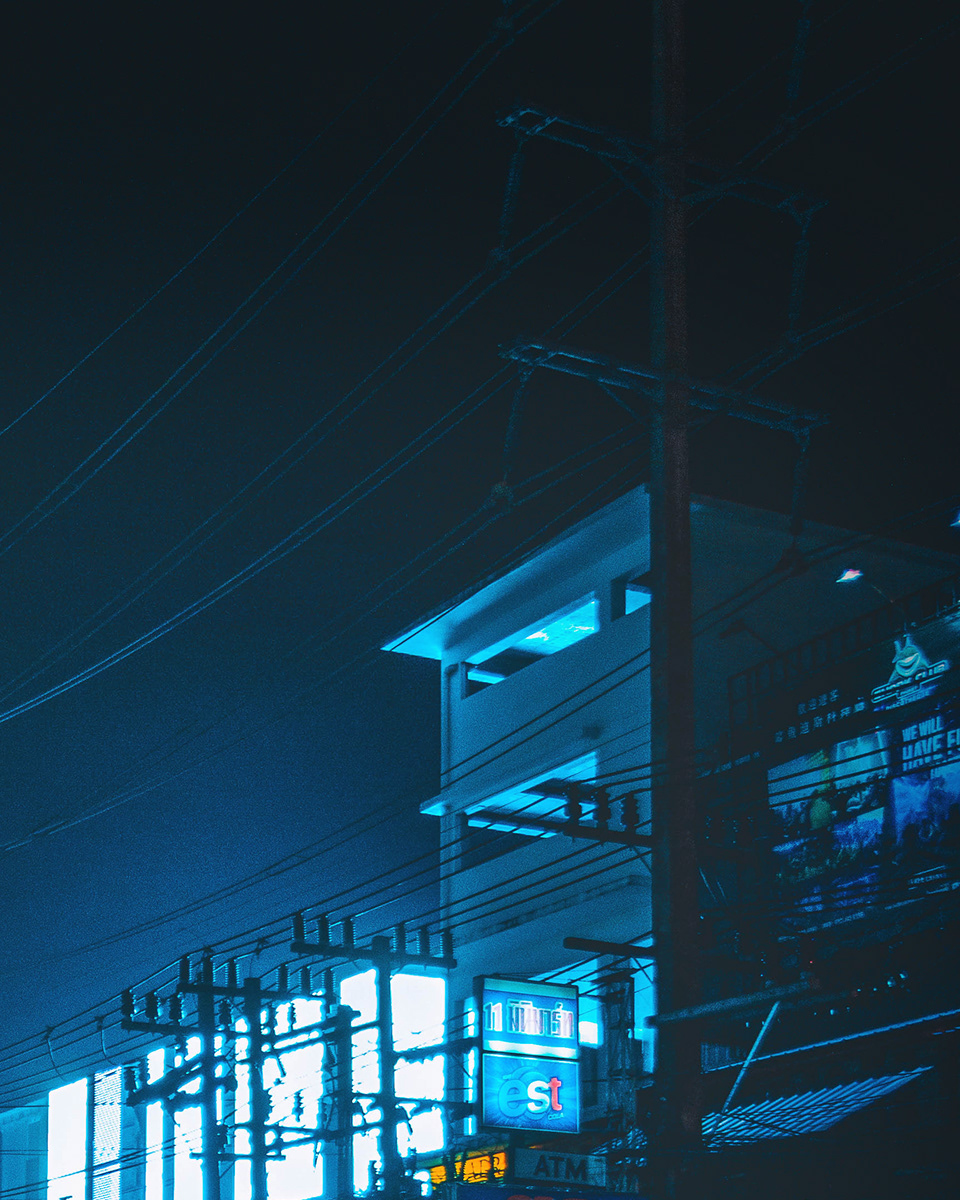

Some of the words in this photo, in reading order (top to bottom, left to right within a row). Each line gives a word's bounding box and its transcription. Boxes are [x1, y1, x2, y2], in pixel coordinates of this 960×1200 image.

[498, 1076, 562, 1118] est
[547, 1112, 564, 1121] COLA
[533, 1154, 588, 1182] ATM
